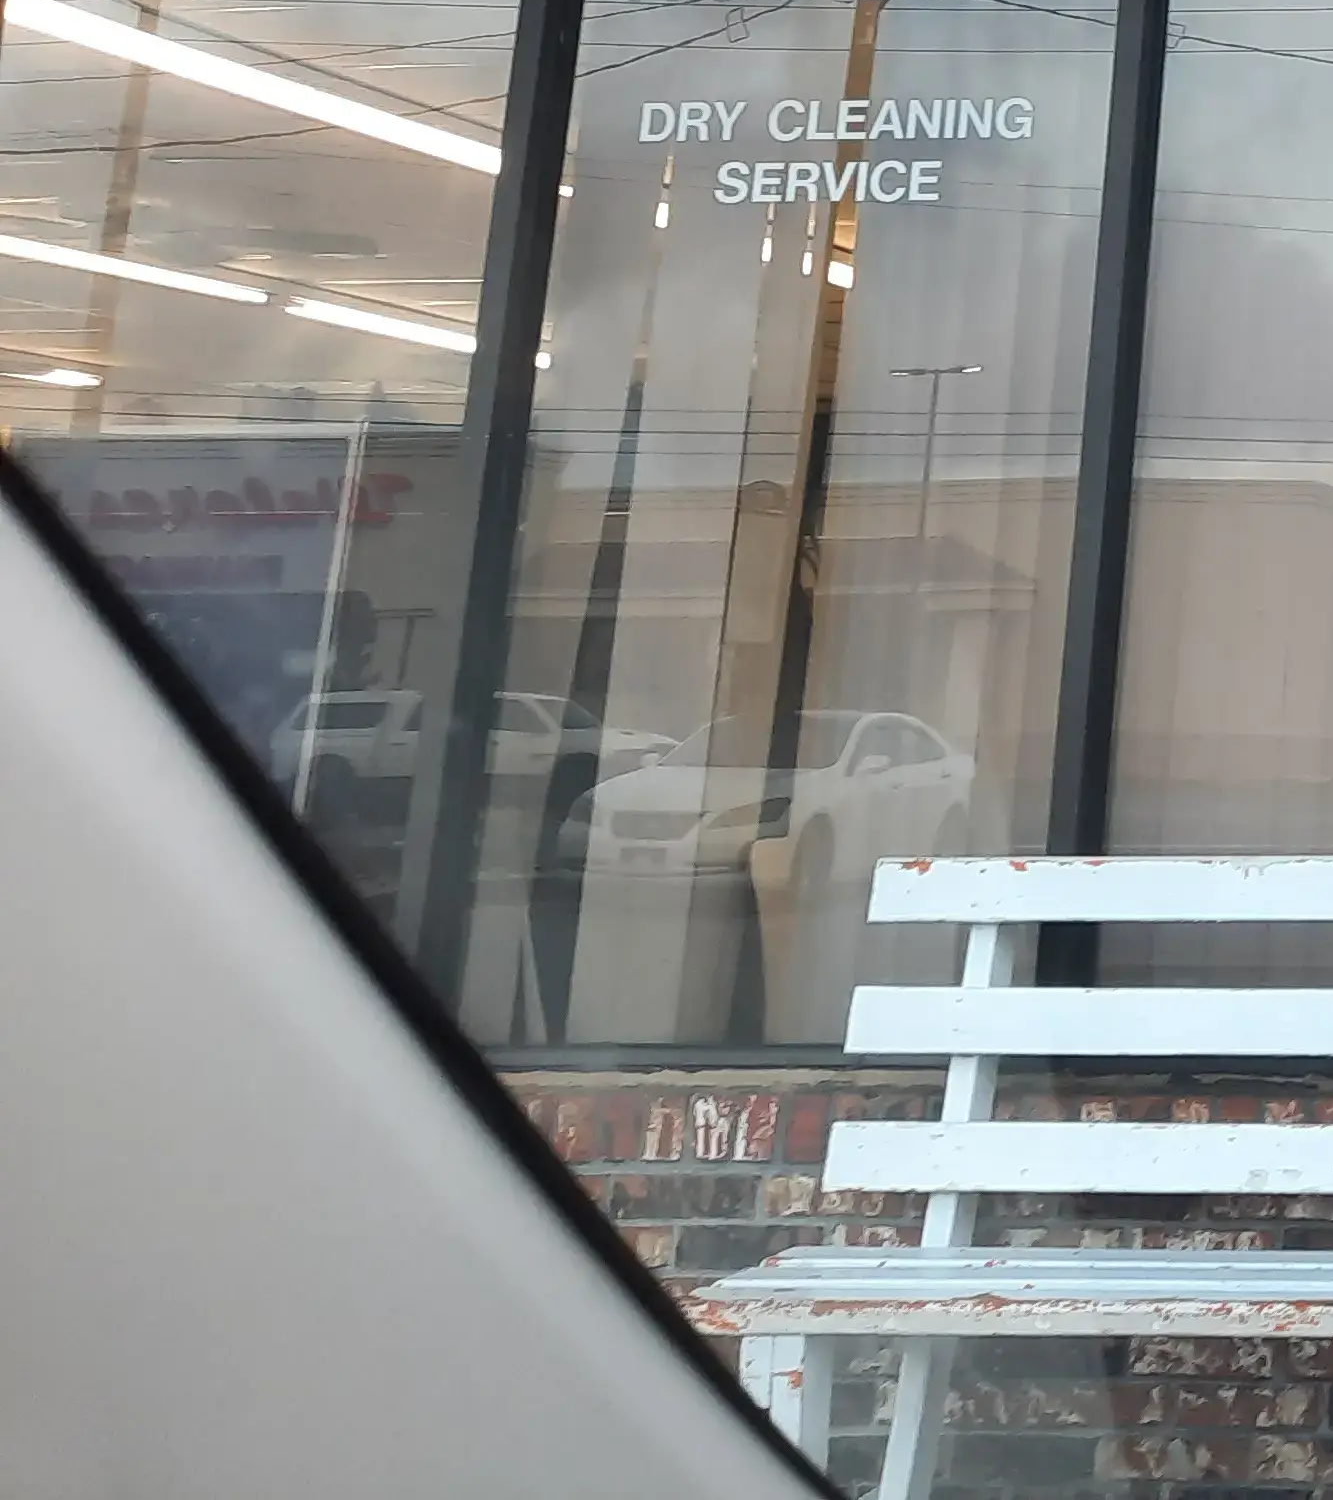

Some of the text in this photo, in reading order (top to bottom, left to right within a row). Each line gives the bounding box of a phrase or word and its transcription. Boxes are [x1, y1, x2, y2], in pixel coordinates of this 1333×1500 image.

[638, 98, 1034, 143] DRY CLEANING
[713, 160, 943, 203] SERVICE
